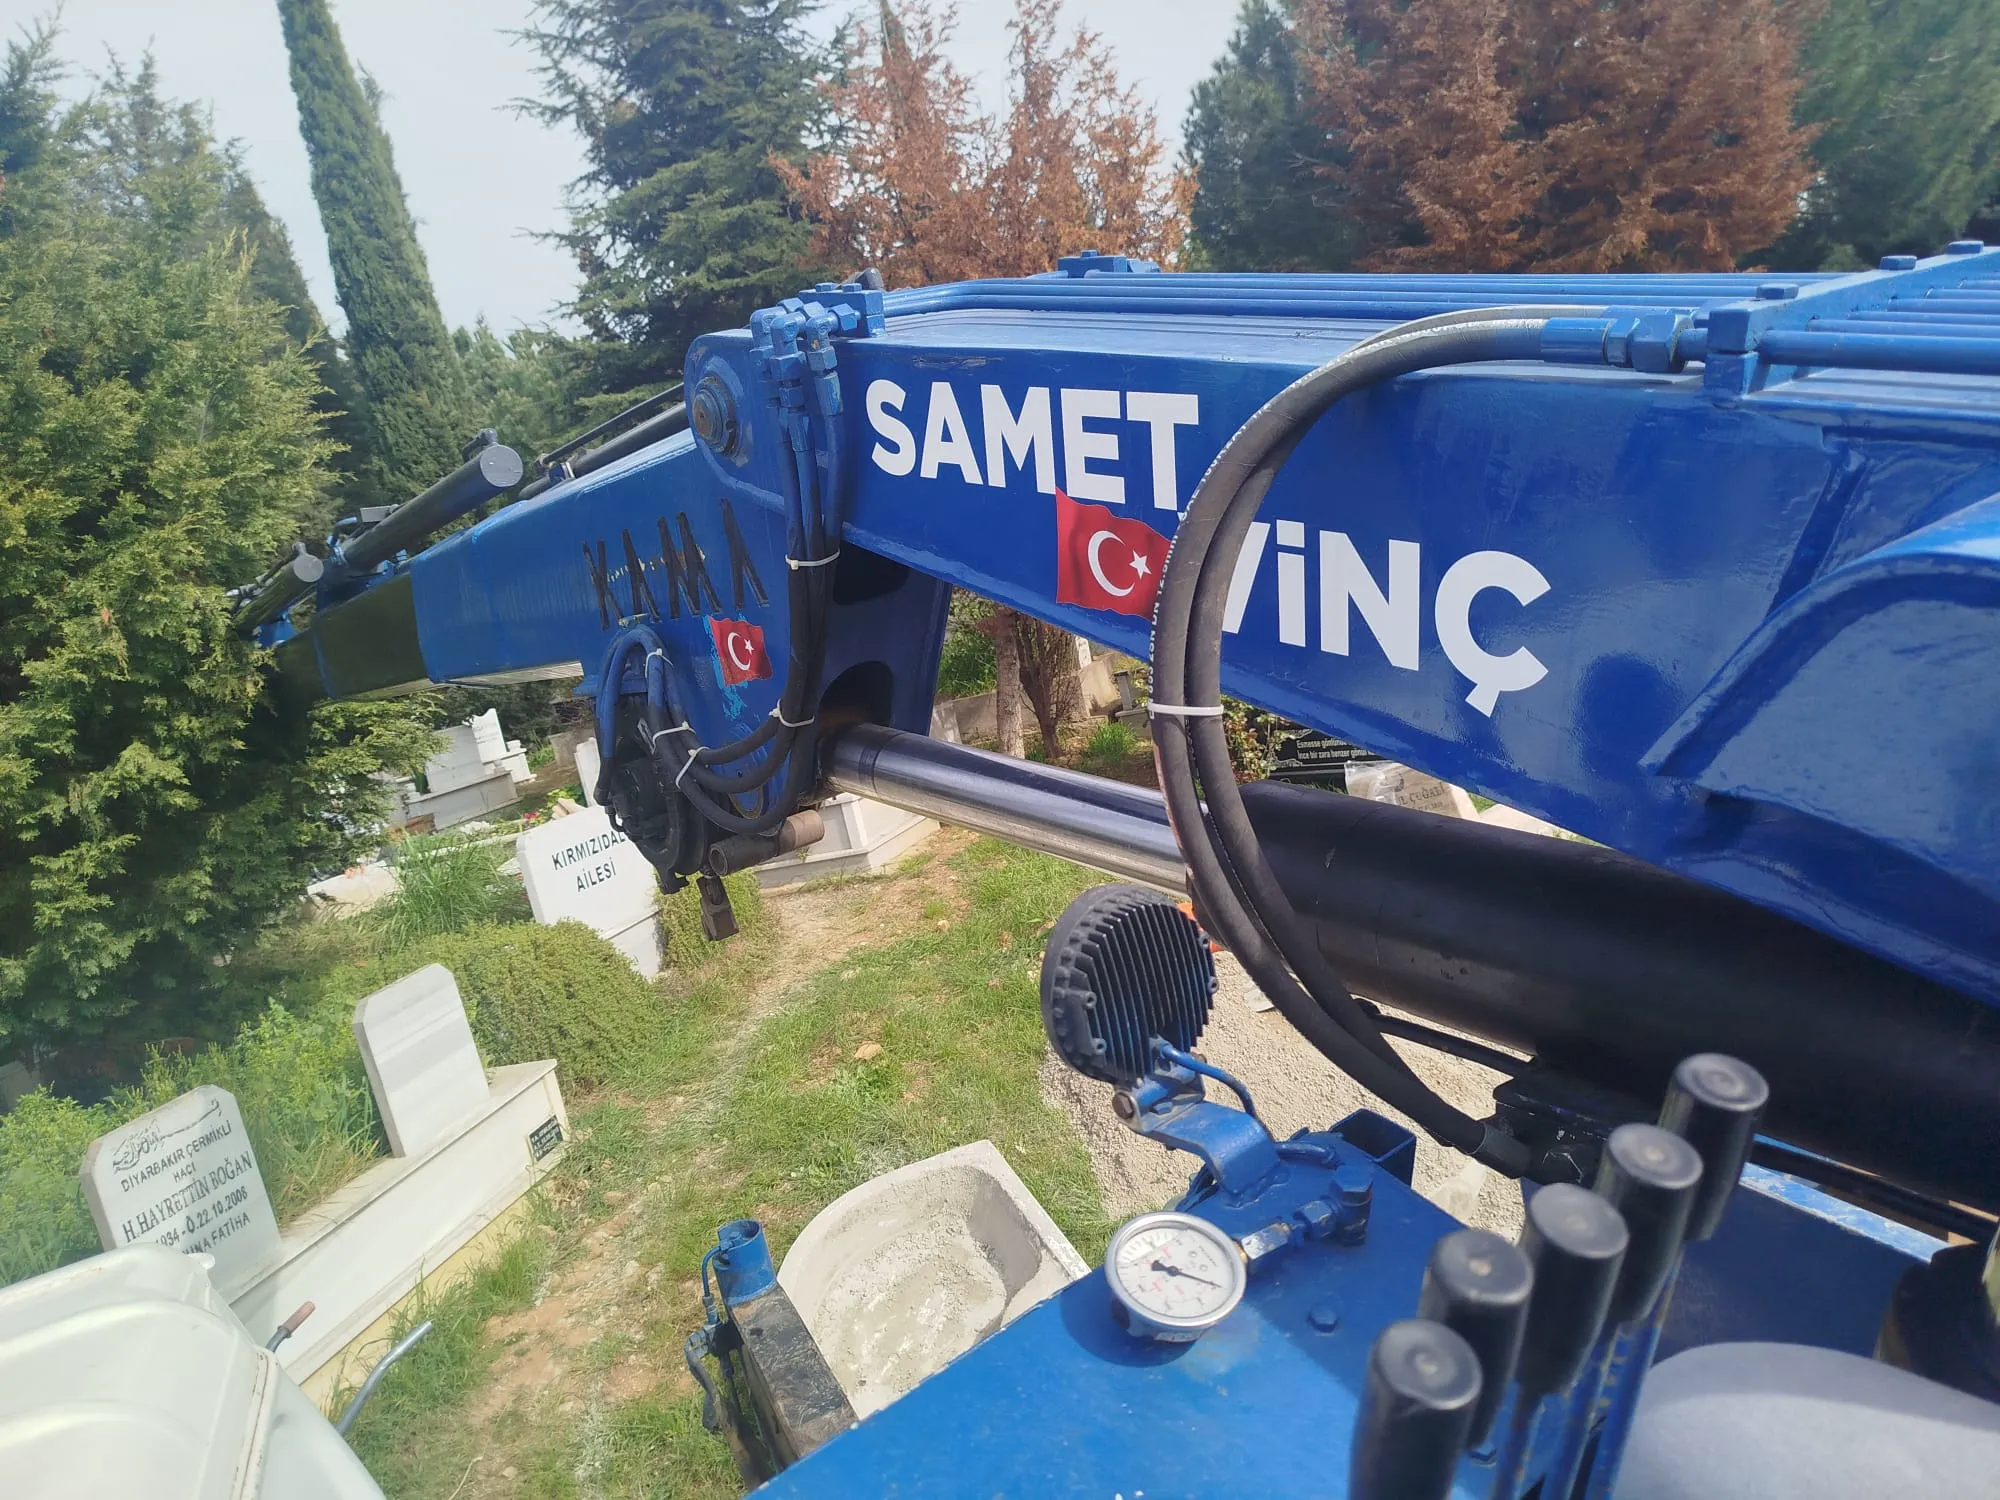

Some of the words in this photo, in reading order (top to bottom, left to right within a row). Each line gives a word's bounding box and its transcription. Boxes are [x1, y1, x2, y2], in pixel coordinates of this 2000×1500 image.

[866, 379, 1198, 511] SAMET
[576, 857, 617, 892] AİLESİ
[121, 1149, 185, 1192] DİYARBAKIR
[186, 1119, 232, 1158] ÇERMİKLİ
[173, 1162, 197, 1183] HACI
[208, 1151, 253, 1190] BOĞAN
[156, 1230, 180, 1247] 934
[211, 1212, 251, 1246] FATİHA
